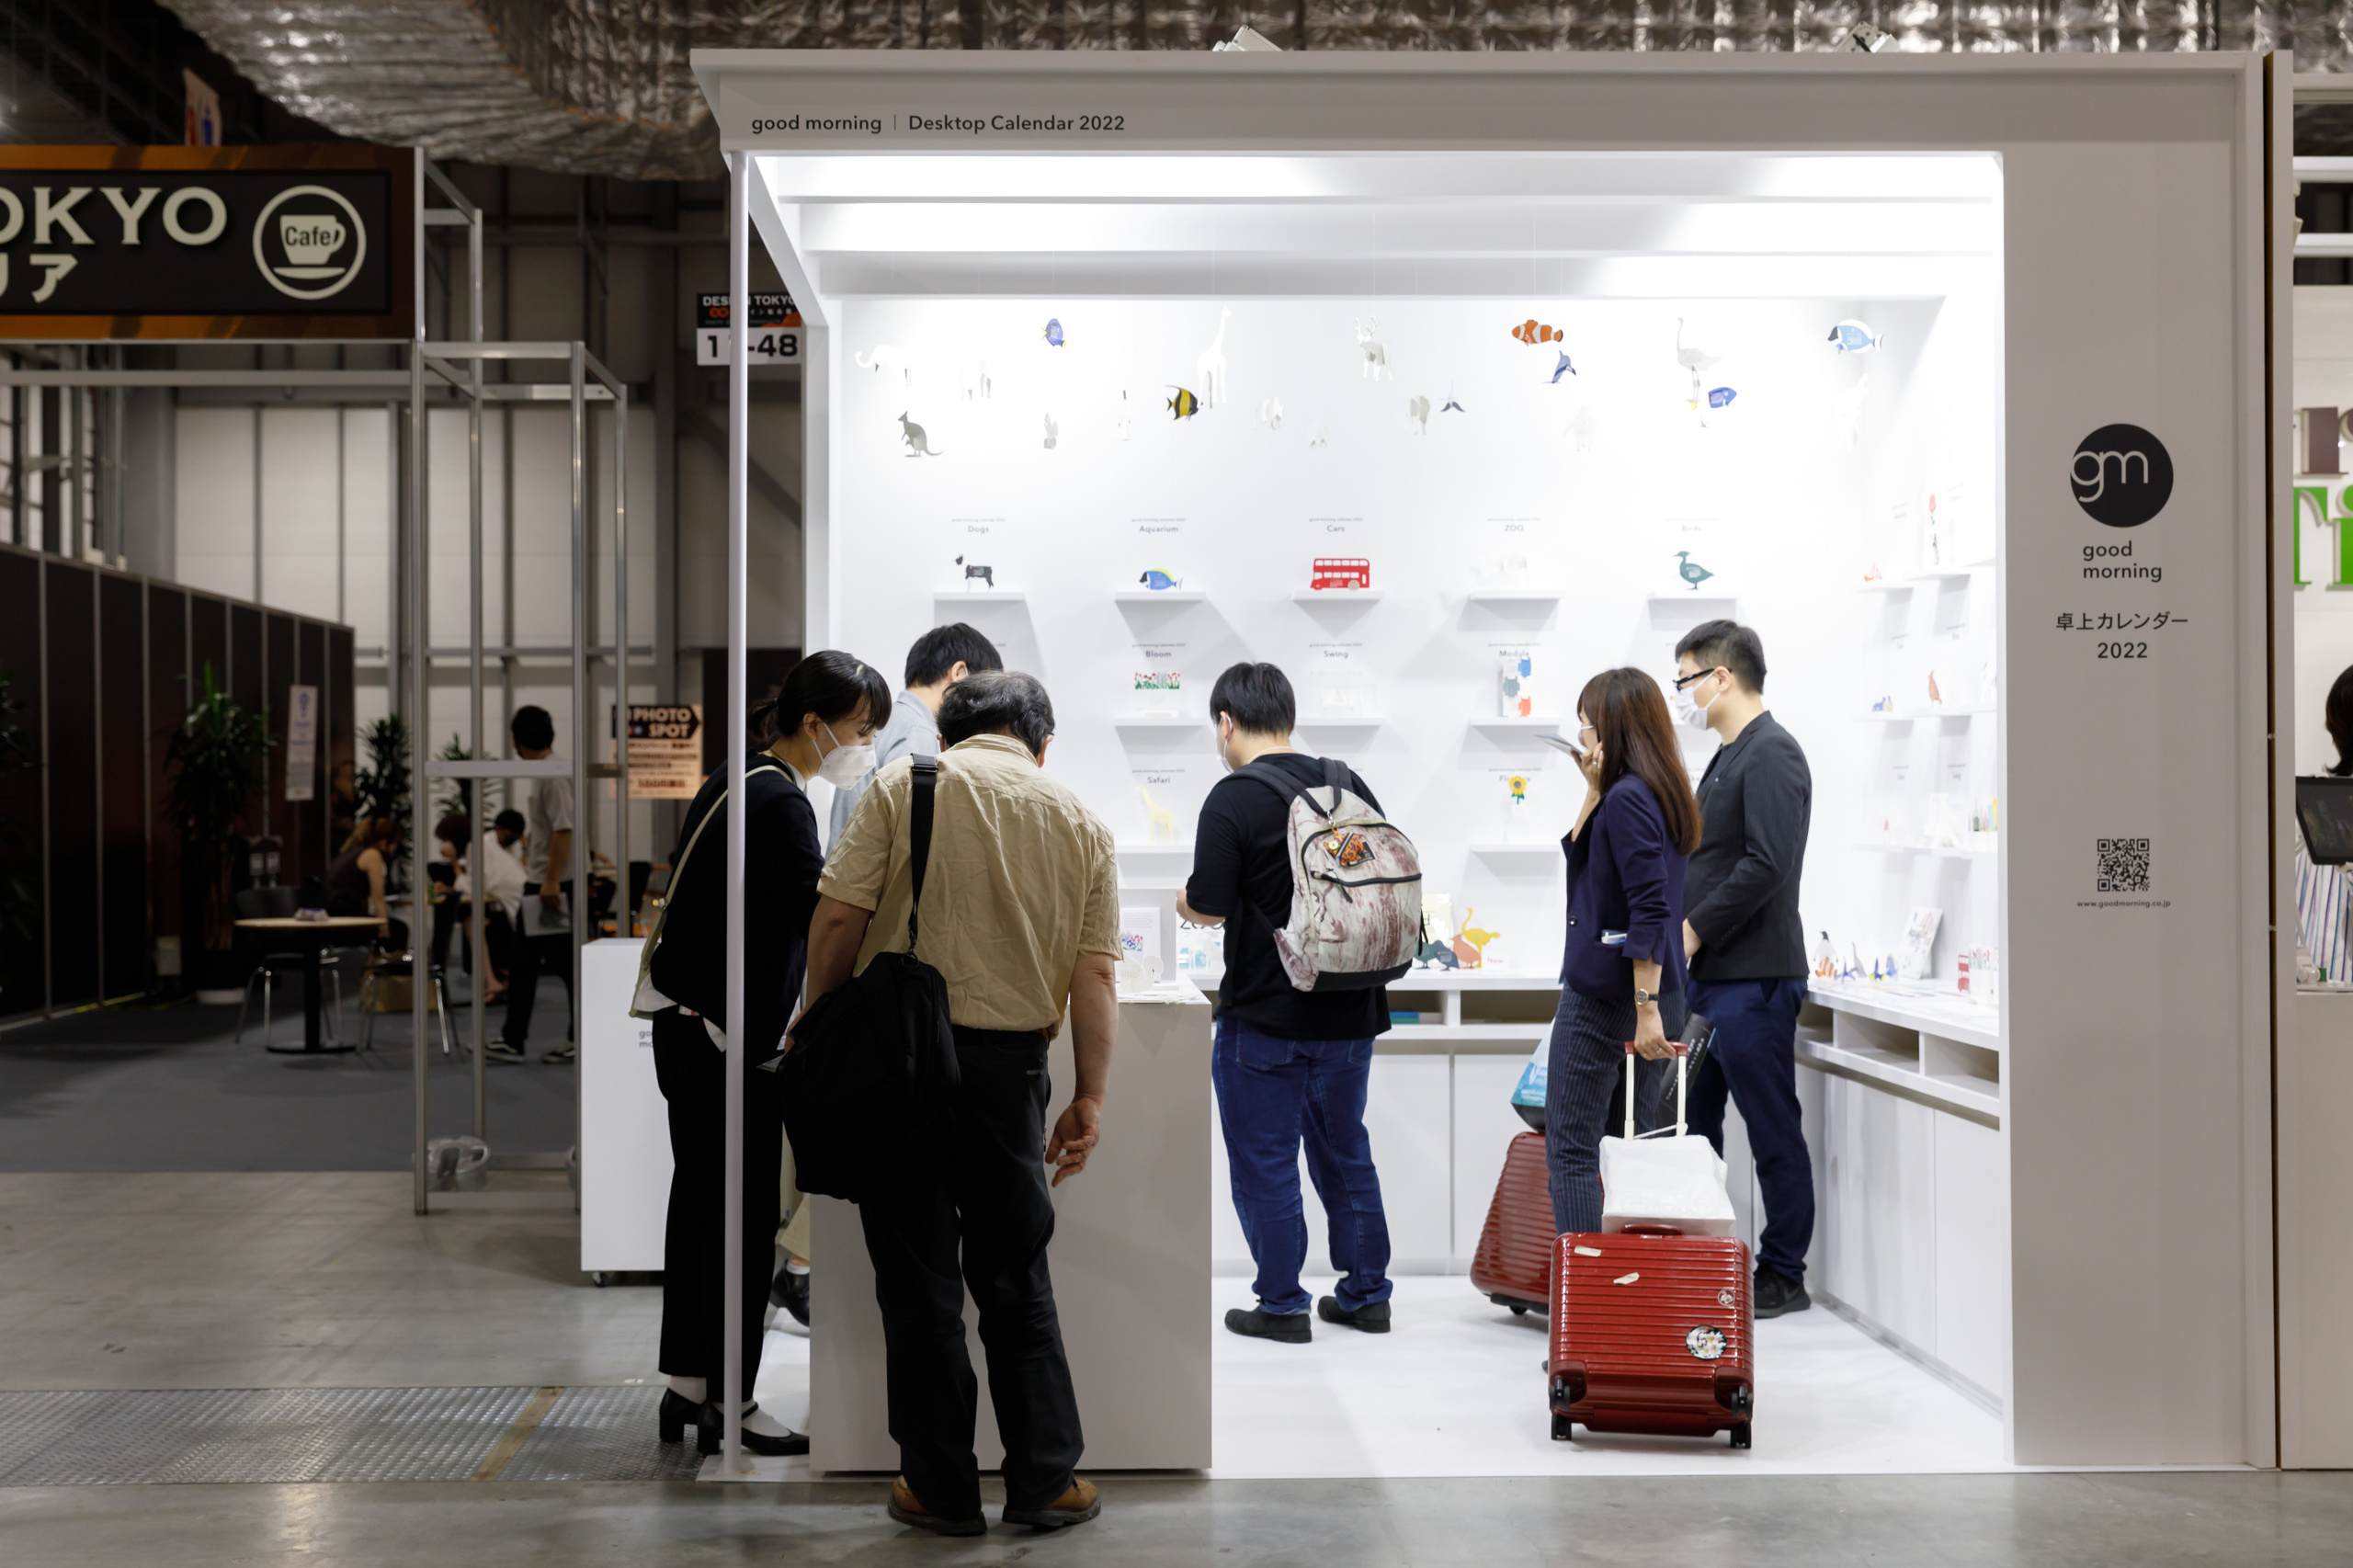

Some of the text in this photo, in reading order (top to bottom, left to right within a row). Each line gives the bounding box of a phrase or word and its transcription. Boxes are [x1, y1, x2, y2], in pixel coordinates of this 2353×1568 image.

[751, 115, 1125, 134] good morning Desktop Calendar 2022
[285, 226, 330, 246] Cafe
[0, 253, 78, 303] ア
[707, 334, 798, 358] 1-48
[2070, 450, 2149, 503] gm
[968, 525, 990, 534] Dogs
[1139, 525, 1179, 534] Aquarium
[1326, 524, 1346, 532] Cars
[1504, 524, 1525, 532] ZOO
[2083, 540, 2132, 562] good
[2083, 563, 2163, 583] morning
[2055, 611, 2188, 631] 卓上カレンダー
[1145, 650, 1172, 658] Bloom
[1324, 650, 1348, 659] Swing
[1498, 650, 1530, 658] Module
[2097, 642, 2148, 659] 2022
[633, 708, 691, 722] PHOTO
[648, 723, 689, 738] SPOT
[1147, 776, 1171, 784] Safari
[2076, 900, 2171, 908] www.goodmorning.co.jp
